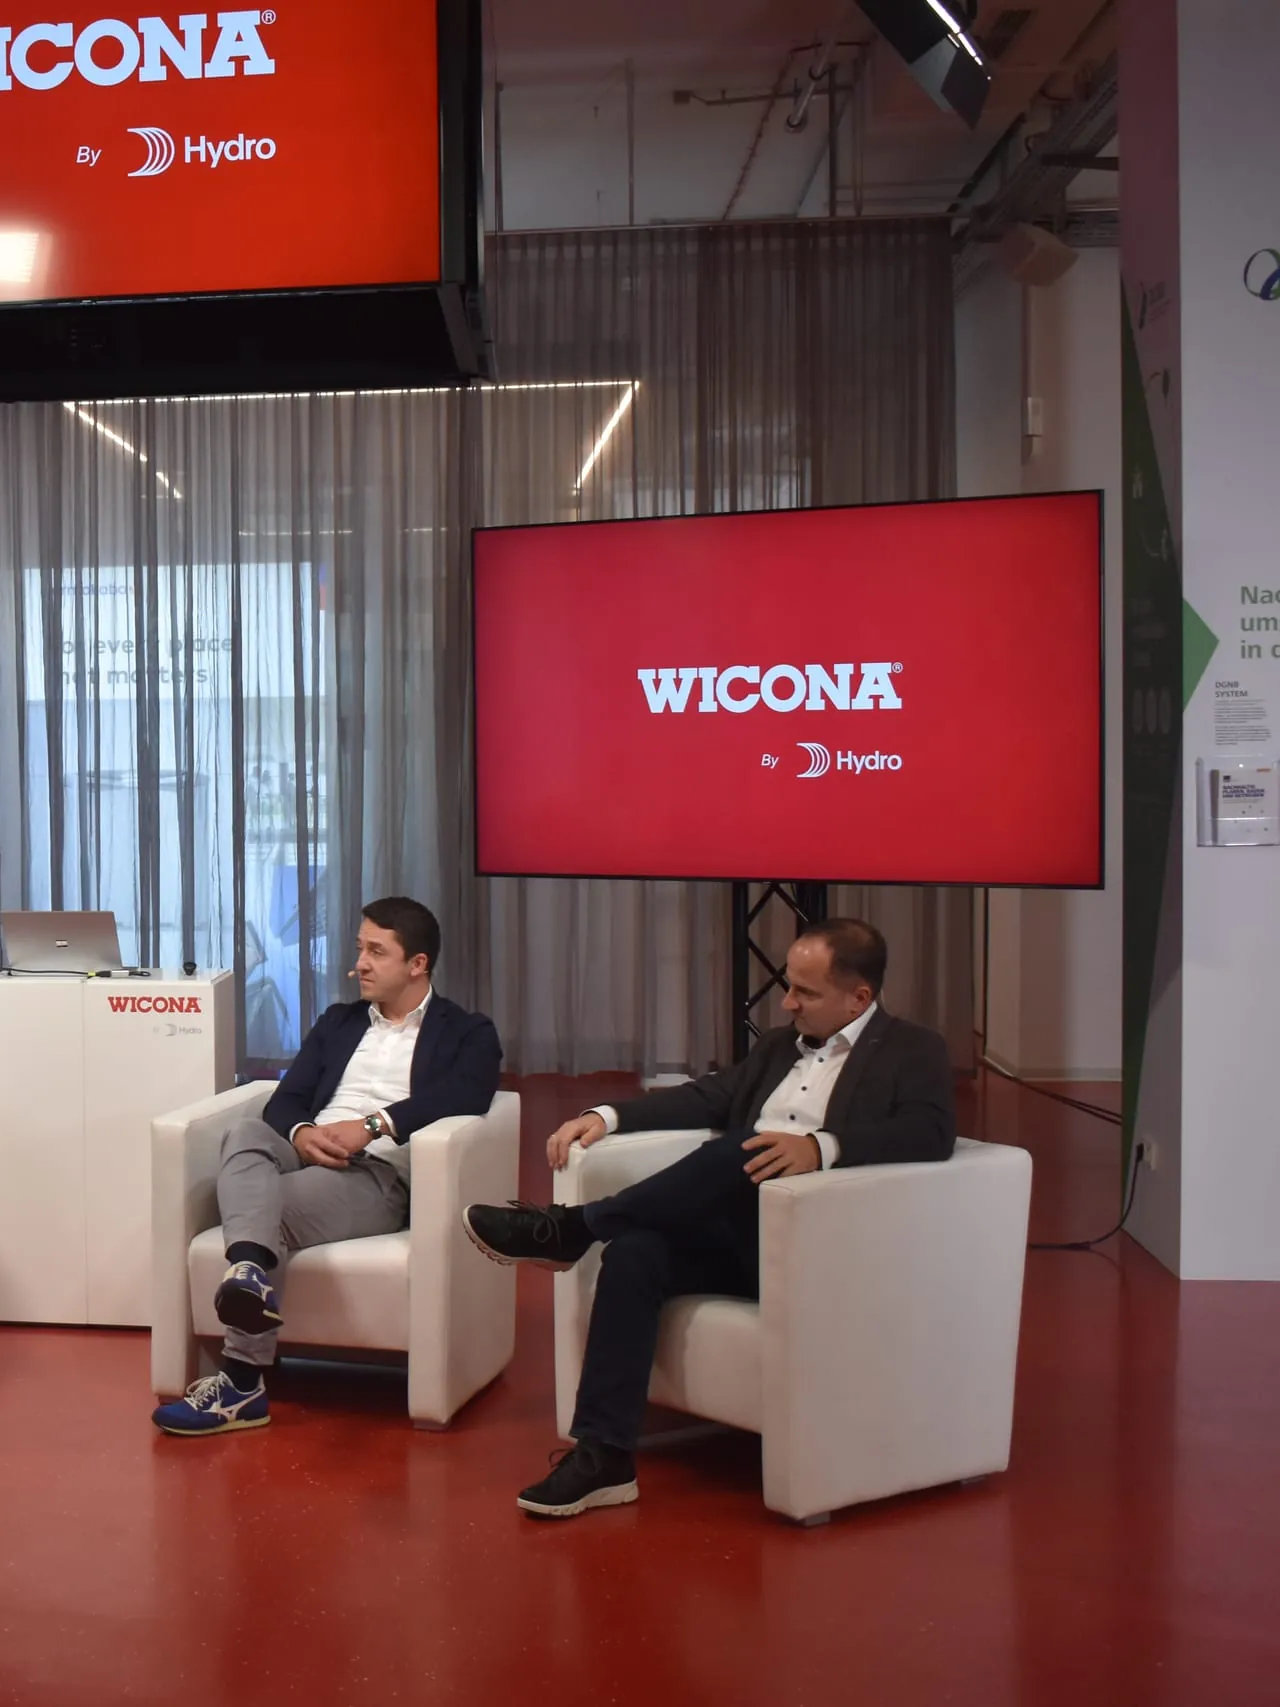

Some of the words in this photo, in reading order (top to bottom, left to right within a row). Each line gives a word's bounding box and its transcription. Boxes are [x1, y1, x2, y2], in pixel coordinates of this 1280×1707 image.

[76, 146, 101, 166] By
[184, 133, 276, 168] Hydro
[1240, 639, 1262, 659] in
[1215, 689, 1248, 699] SYSTEM
[761, 753, 779, 769] By
[836, 751, 903, 775] Hydro
[107, 996, 202, 1013] WICONA
